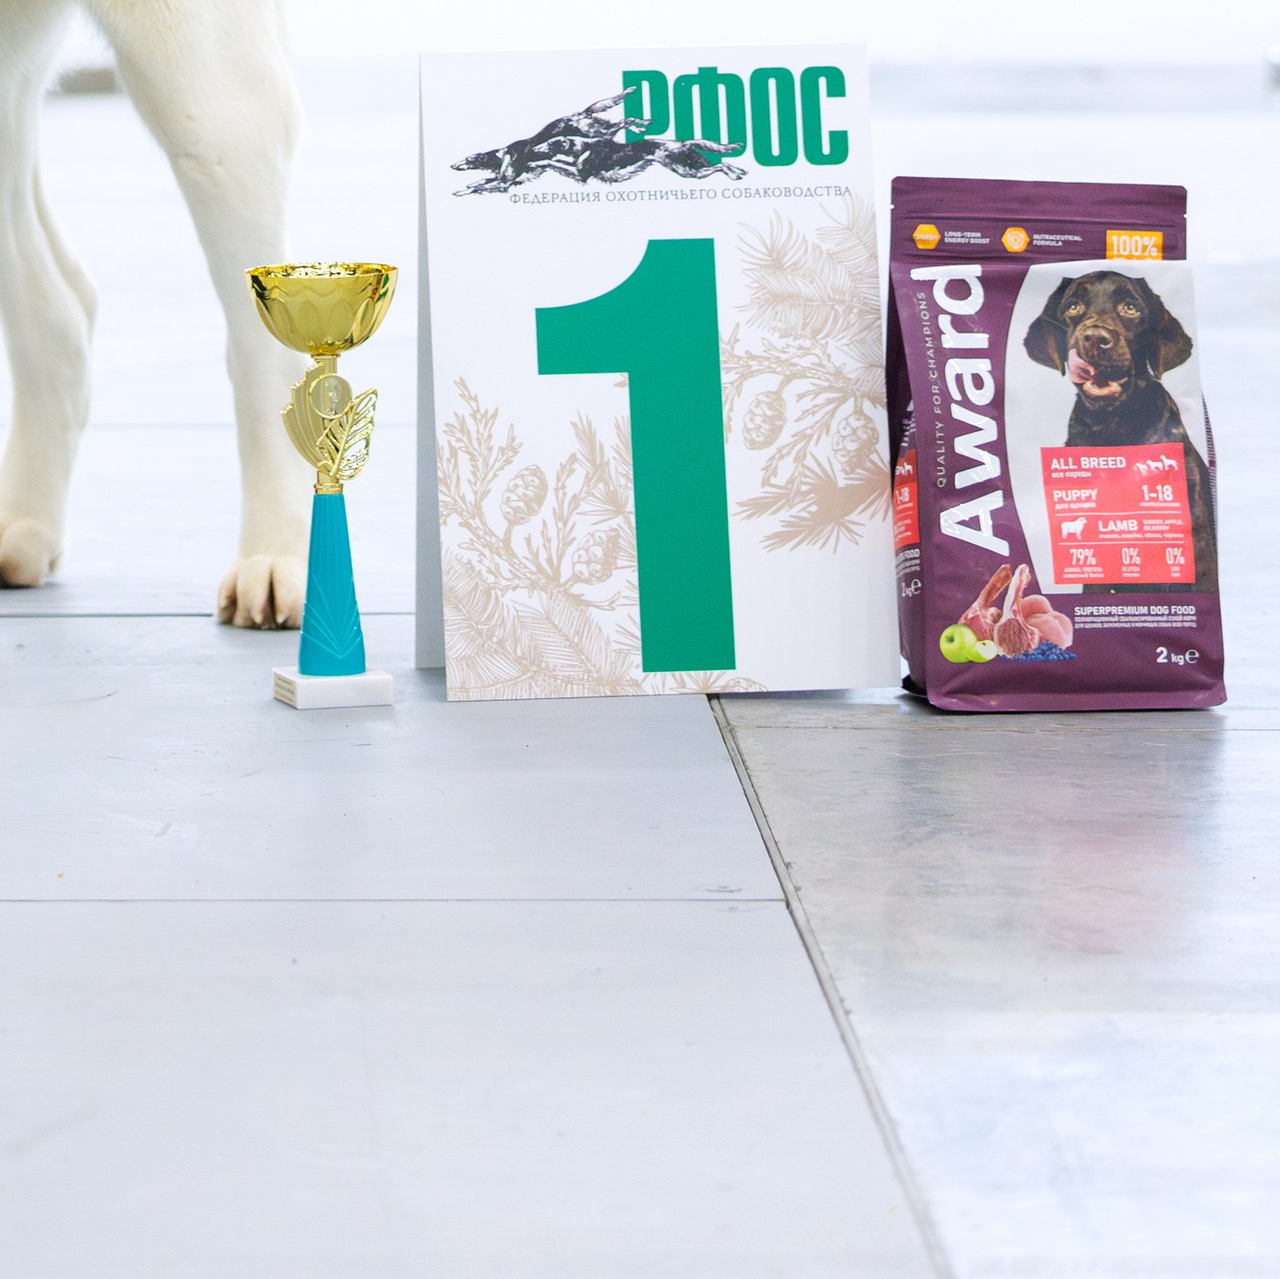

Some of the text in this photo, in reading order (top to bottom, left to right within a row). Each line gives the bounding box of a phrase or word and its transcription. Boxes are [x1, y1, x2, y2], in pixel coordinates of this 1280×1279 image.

[622, 66, 849, 166] РФОС
[509, 185, 853, 205] ФЕДЕРАЦИЯ ОХОТНИЧЬЕГО СОБАКОВОДСТВА
[1111, 235, 1158, 257] 100%
[917, 292, 947, 488] QUALITY FOR CHAMPIONS
[910, 264, 1010, 557] Award
[535, 238, 736, 673] 1
[1050, 457, 1126, 470] ALL BREED
[1053, 485, 1174, 502] PUPPY 1-18
[1098, 519, 1139, 532] LAMB
[1069, 547, 1185, 565] 79% 0% 0%
[1074, 606, 1196, 615] SUPERPREMIUM DOG FOOD
[1156, 646, 1168, 663] 2
